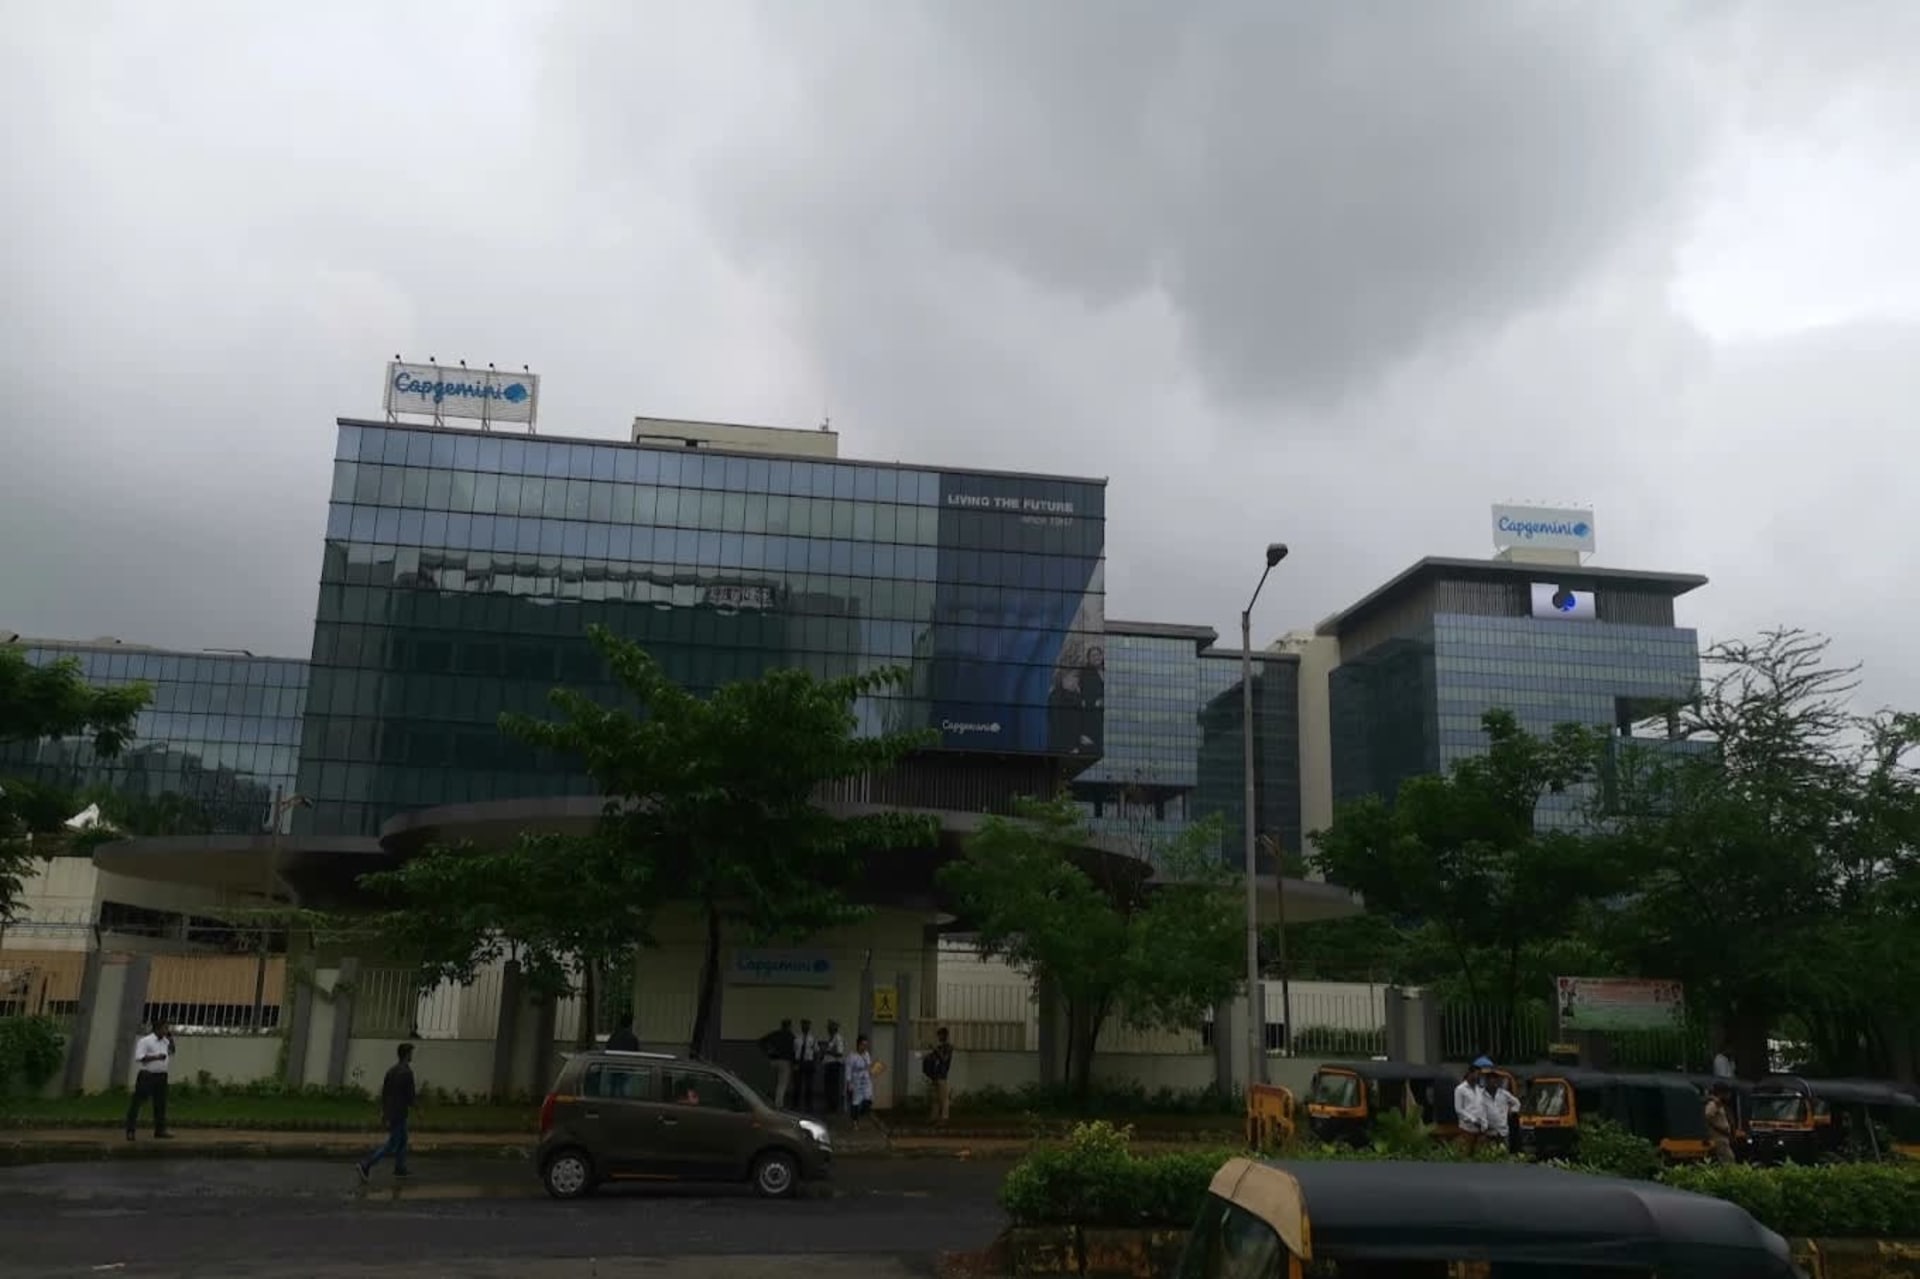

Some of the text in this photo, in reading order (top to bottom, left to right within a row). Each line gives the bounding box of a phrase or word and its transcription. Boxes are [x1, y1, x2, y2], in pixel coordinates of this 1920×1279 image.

[395, 372, 503, 404] Capgemini
[948, 493, 1073, 513] LIVING THE FUTURE
[1498, 516, 1572, 538] Capgemini
